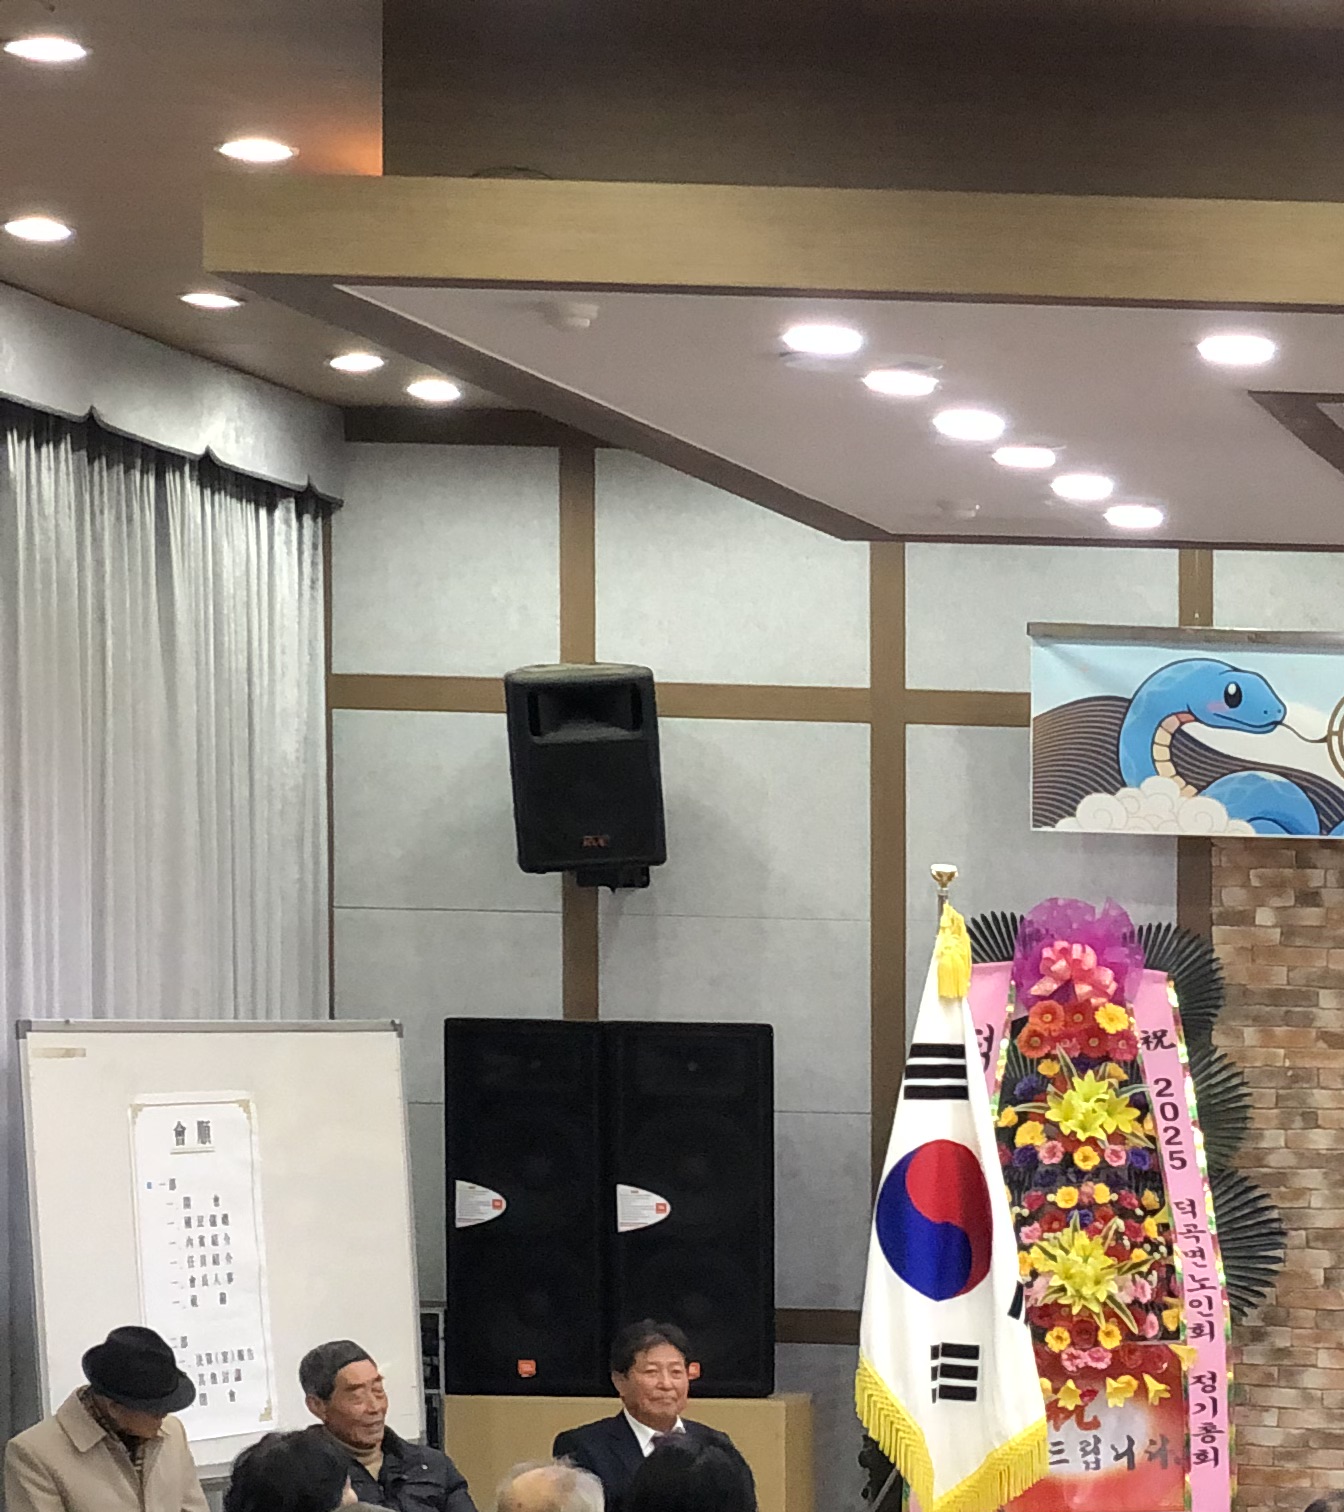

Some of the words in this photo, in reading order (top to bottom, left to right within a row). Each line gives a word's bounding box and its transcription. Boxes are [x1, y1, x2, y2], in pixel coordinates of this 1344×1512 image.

[1140, 1029, 1175, 1051] 祝
[1153, 1078, 1188, 1170] 2025
[1190, 1370, 1224, 1468] 정기총회
